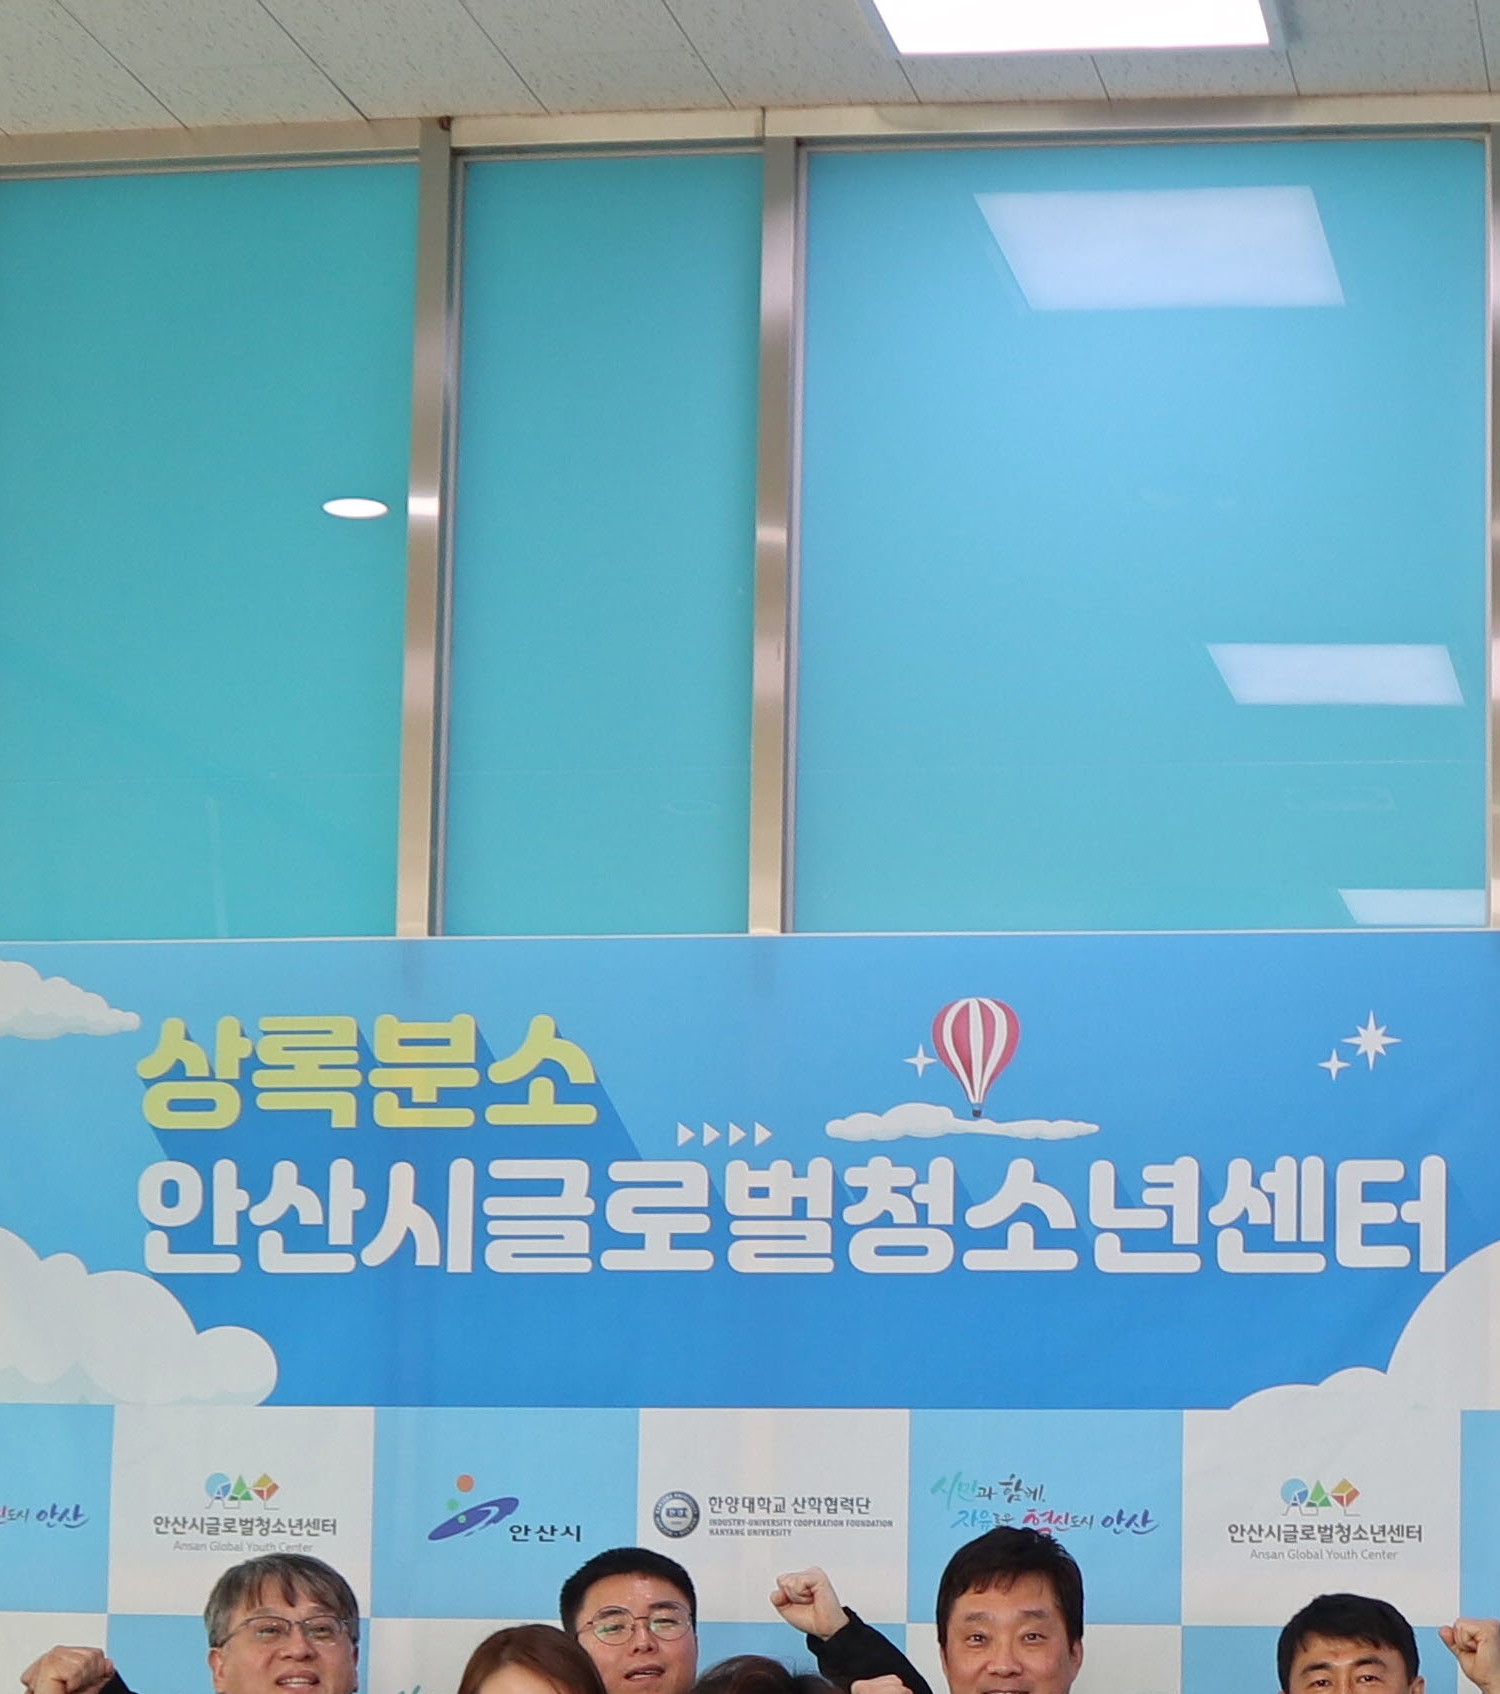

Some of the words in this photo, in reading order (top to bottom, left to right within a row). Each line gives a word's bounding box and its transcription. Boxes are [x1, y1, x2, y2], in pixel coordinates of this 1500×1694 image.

[136, 1013, 598, 1130] 상록분소
[137, 1154, 1447, 1274] 안산시글로벌청소년센터
[930, 1471, 996, 1509] 시민과
[36, 1502, 90, 1529] 안산
[708, 1496, 787, 1514] 한양대학교
[791, 1496, 871, 1514] 산학협력단
[153, 1515, 337, 1537] 안산시글로벌청소년센터
[709, 1528, 745, 1537] HANYANG
[747, 1528, 792, 1537] UNIVERSITY
[1101, 1508, 1159, 1535] 안산
[509, 1524, 581, 1543] 안산시
[1228, 1522, 1422, 1544] 안산시글로벌청소년센터
[173, 1540, 207, 1551] Ansan
[209, 1540, 244, 1552] Global
[246, 1541, 276, 1552] Youth
[278, 1541, 314, 1553] Center
[1250, 1549, 1285, 1560] Ansan
[1287, 1549, 1324, 1560] Global
[1326, 1549, 1358, 1560] Youth
[1360, 1549, 1399, 1560] Center
